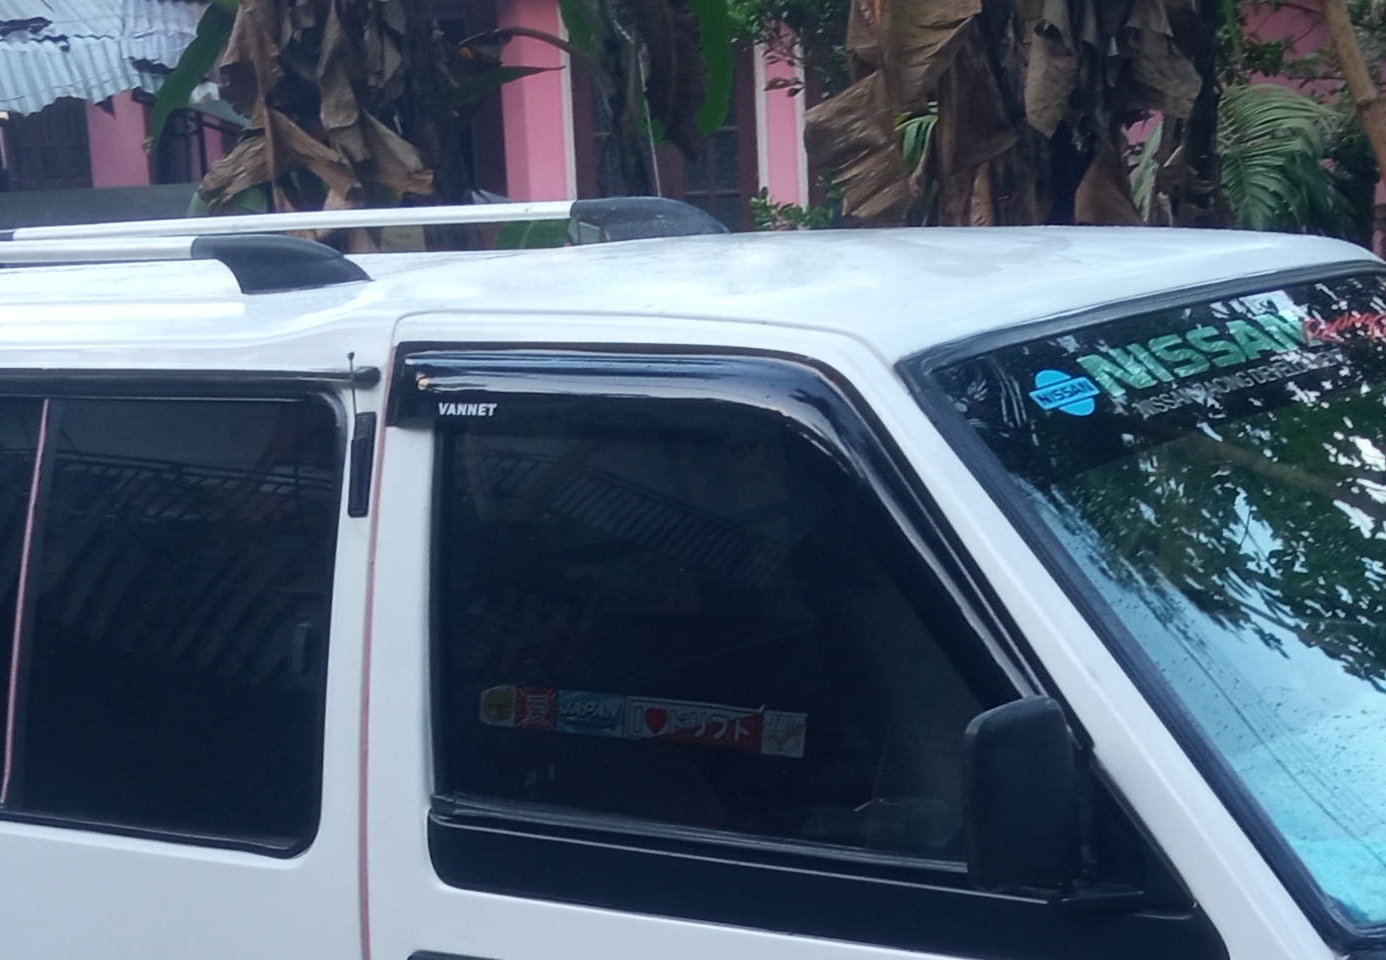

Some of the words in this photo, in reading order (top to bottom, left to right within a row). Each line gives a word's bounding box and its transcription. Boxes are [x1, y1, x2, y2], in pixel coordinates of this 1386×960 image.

[1076, 308, 1321, 396] NISSAN
[1036, 380, 1095, 404] NISSAN
[438, 402, 497, 417] VANNET
[560, 699, 621, 721] JAPAN
[668, 708, 750, 742] ドリフト
